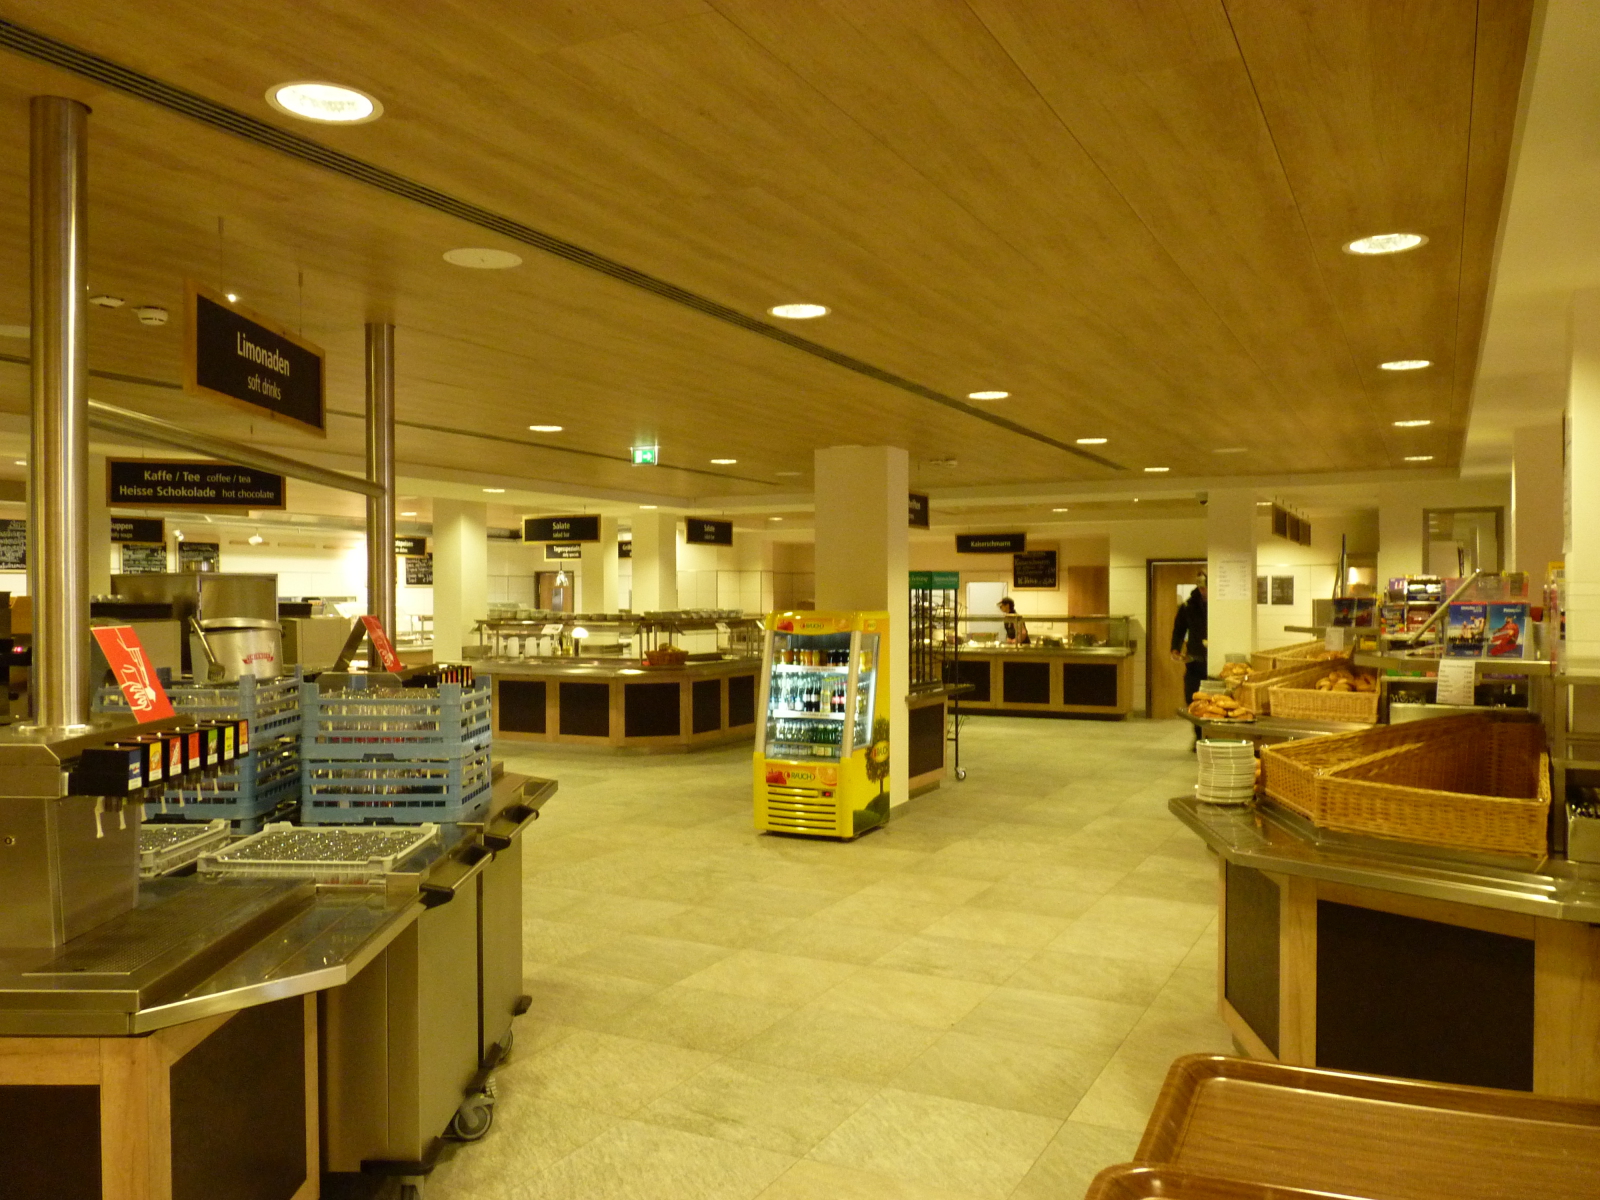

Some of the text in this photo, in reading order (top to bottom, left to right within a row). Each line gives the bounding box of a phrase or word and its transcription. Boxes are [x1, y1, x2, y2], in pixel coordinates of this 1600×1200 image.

[237, 331, 290, 376] Limonaden
[247, 373, 282, 401] soft drinks
[144, 470, 173, 482] Kaffe
[182, 471, 200, 482] Tee
[206, 473, 231, 484] coffee
[238, 474, 252, 484] tea
[119, 485, 275, 499] Heisse Schokolade hot chocolate
[552, 522, 570, 530] Salate
[970, 539, 1011, 548] Kaiserschmarrn
[791, 771, 812, 780] RAUCH
